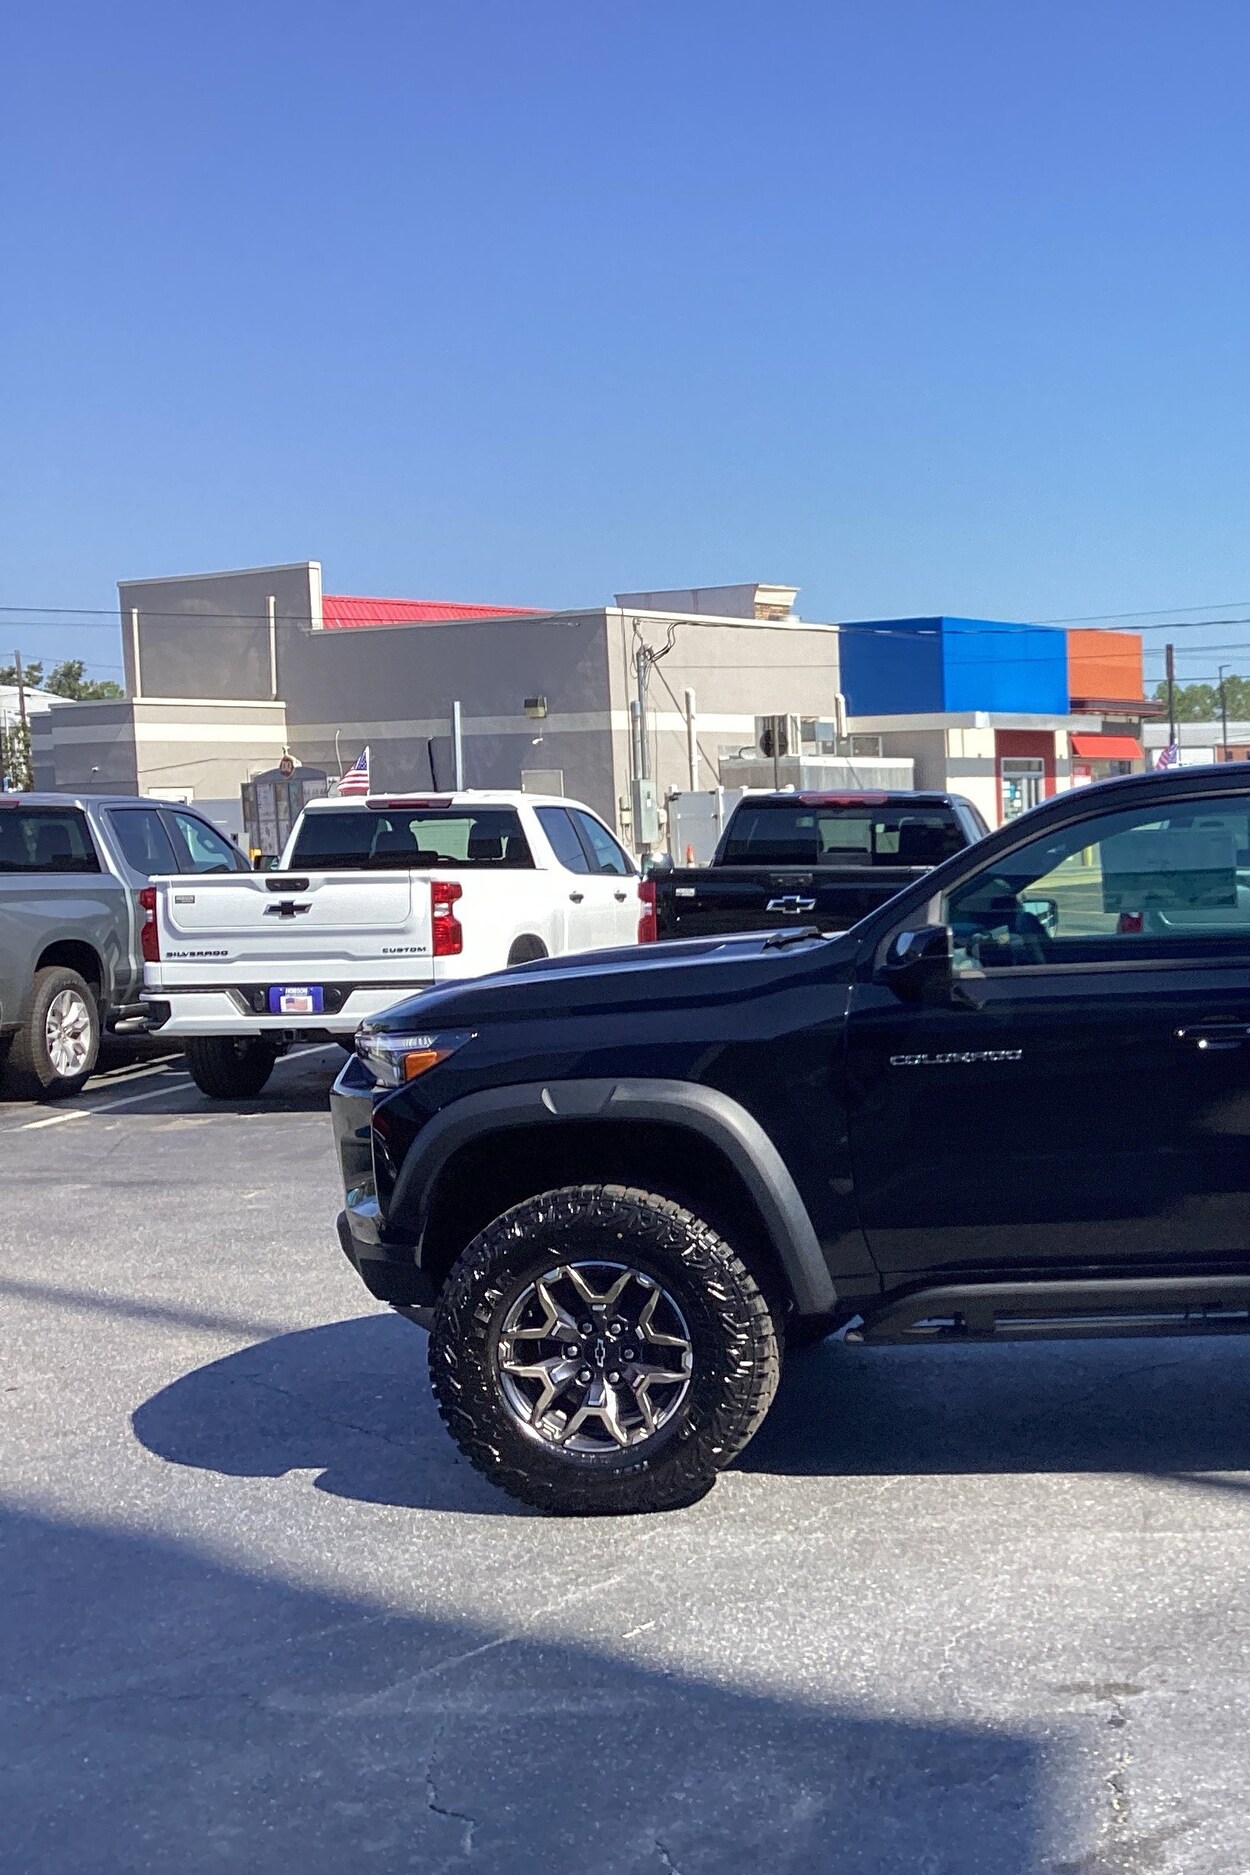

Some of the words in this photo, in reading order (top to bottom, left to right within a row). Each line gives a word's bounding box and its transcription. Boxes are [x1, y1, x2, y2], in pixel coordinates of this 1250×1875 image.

[166, 950, 229, 958] SILVERADO
[382, 946, 426, 954] CUSTOM
[889, 1049, 1023, 1066] COLORADO
